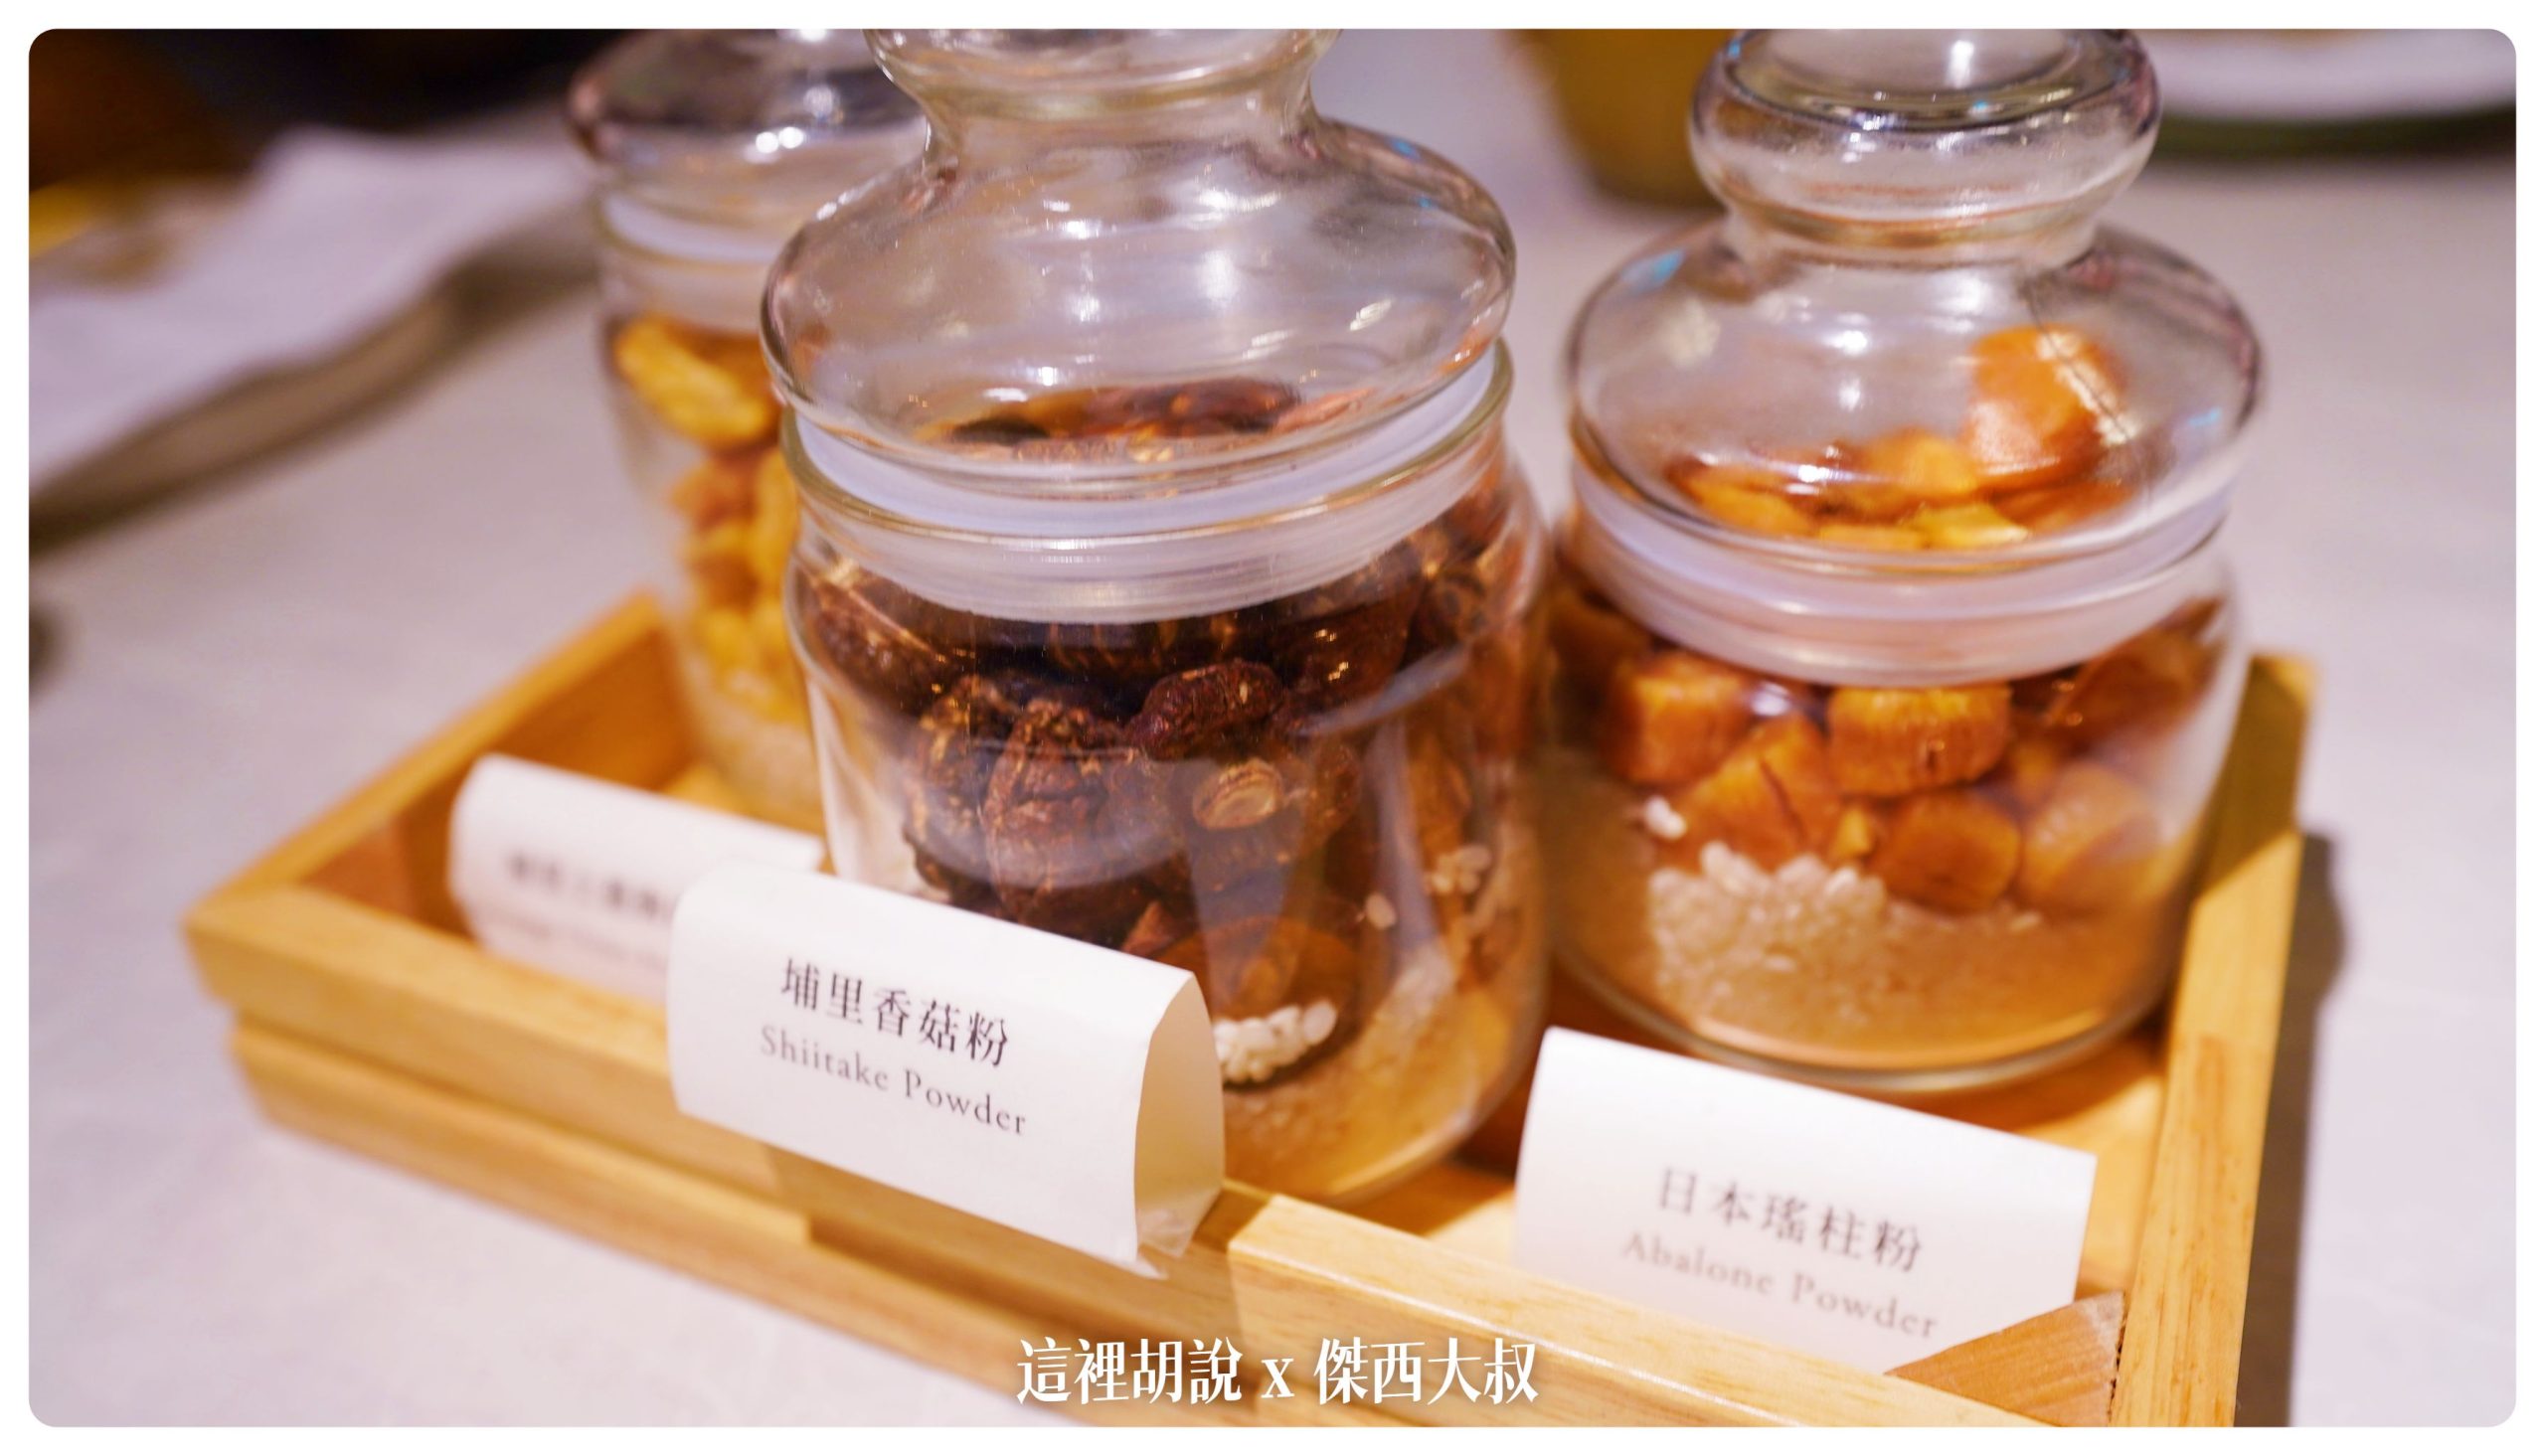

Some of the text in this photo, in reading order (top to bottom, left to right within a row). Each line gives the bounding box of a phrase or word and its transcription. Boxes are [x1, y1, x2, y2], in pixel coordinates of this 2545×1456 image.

[781, 957, 1009, 1065] 埔里香菇粉
[761, 1025, 1026, 1135] Shiitake Powder
[1623, 1231, 1938, 1339] Abalone Powder
